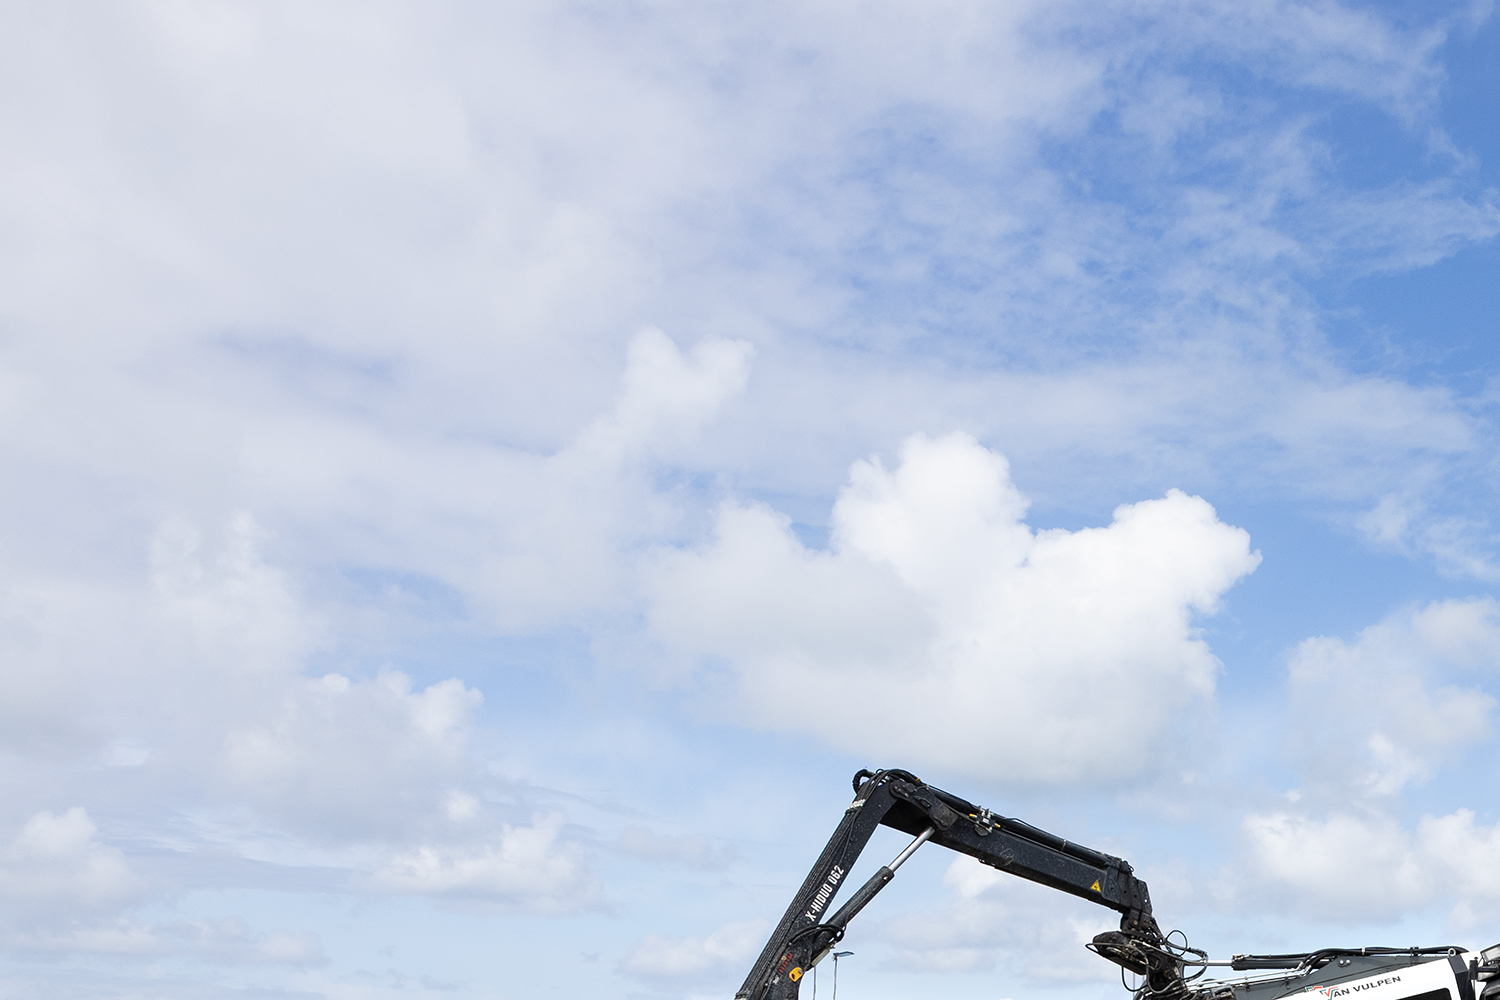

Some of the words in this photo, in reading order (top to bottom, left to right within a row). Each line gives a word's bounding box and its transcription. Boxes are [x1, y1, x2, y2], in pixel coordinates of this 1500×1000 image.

[805, 883, 833, 922] X-HIDUO
[827, 865, 845, 885] 062
[1352, 975, 1402, 992] VULPEN
